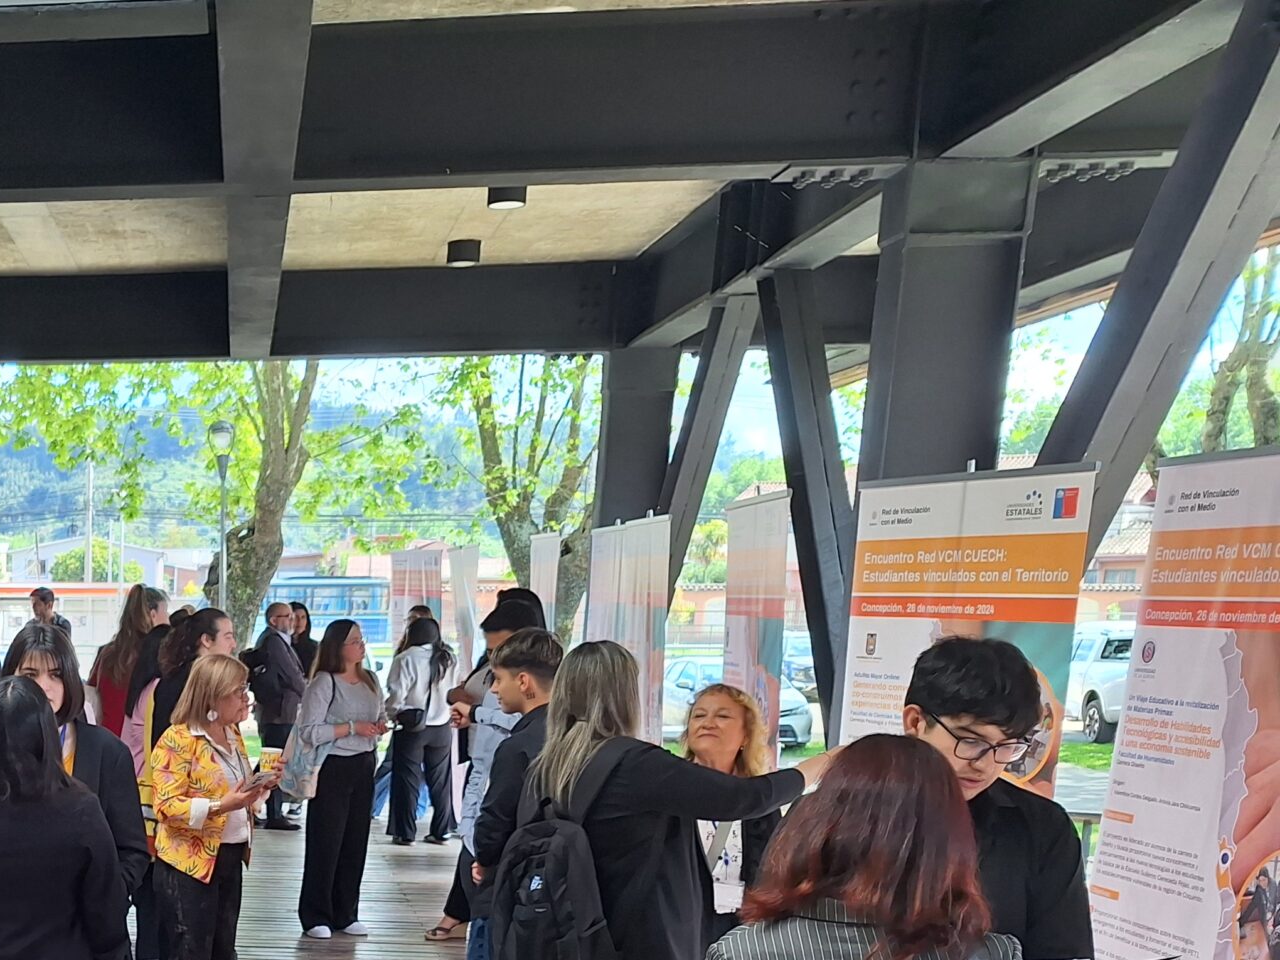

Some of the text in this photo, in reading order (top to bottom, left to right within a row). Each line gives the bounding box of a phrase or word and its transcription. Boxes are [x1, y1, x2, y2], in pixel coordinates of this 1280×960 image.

[1180, 487, 1240, 500] Red de Vinculación
[881, 508, 891, 516] Red
[900, 505, 931, 515] Vinculación
[1006, 507, 1042, 516] ESTATALES
[1178, 503, 1216, 513] con el Medio
[897, 517, 912, 525] Medio
[864, 548, 1008, 564] Encuentro Red VCM CUECH:
[1155, 546, 1212, 561] Encuentro
[1215, 544, 1238, 559] Red
[1243, 543, 1272, 559] VCM
[863, 568, 1069, 582] Estudiantes vinculados con el Territorio
[1151, 566, 1280, 583] Estudiantes vinculado
[917, 603, 926, 612] de
[926, 603, 962, 613] noviembre
[964, 604, 974, 614] de
[976, 604, 994, 614] 2024
[1145, 608, 1194, 622] Concepción,
[1208, 610, 1218, 622] de
[1219, 609, 1267, 623] noviembre
[1268, 611, 1280, 624] de
[1149, 696, 1174, 706] Educativo
[1125, 715, 1211, 735] Desarrollo de Habilidades
[1174, 746, 1211, 760] sostenible
